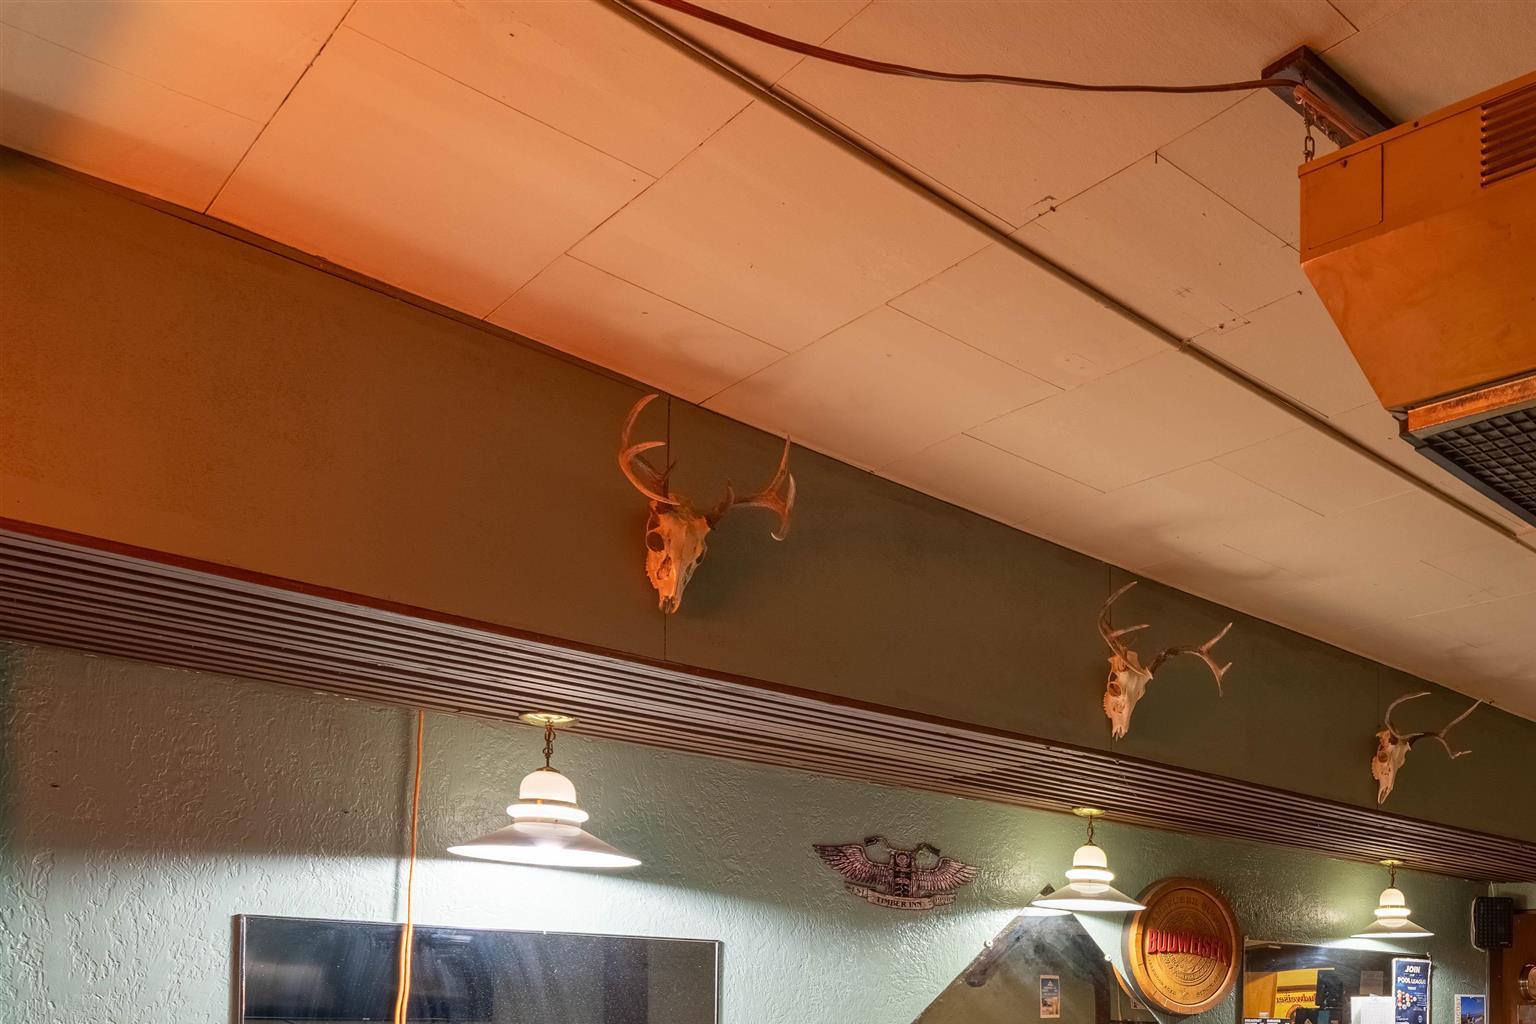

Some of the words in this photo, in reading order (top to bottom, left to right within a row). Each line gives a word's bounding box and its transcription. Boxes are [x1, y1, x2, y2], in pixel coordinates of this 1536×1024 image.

[877, 897, 907, 907] TIMBER
[1147, 927, 1231, 968] BUDWEISER
[1405, 965, 1420, 973] JOIN
[1397, 976, 1411, 984] POOL
